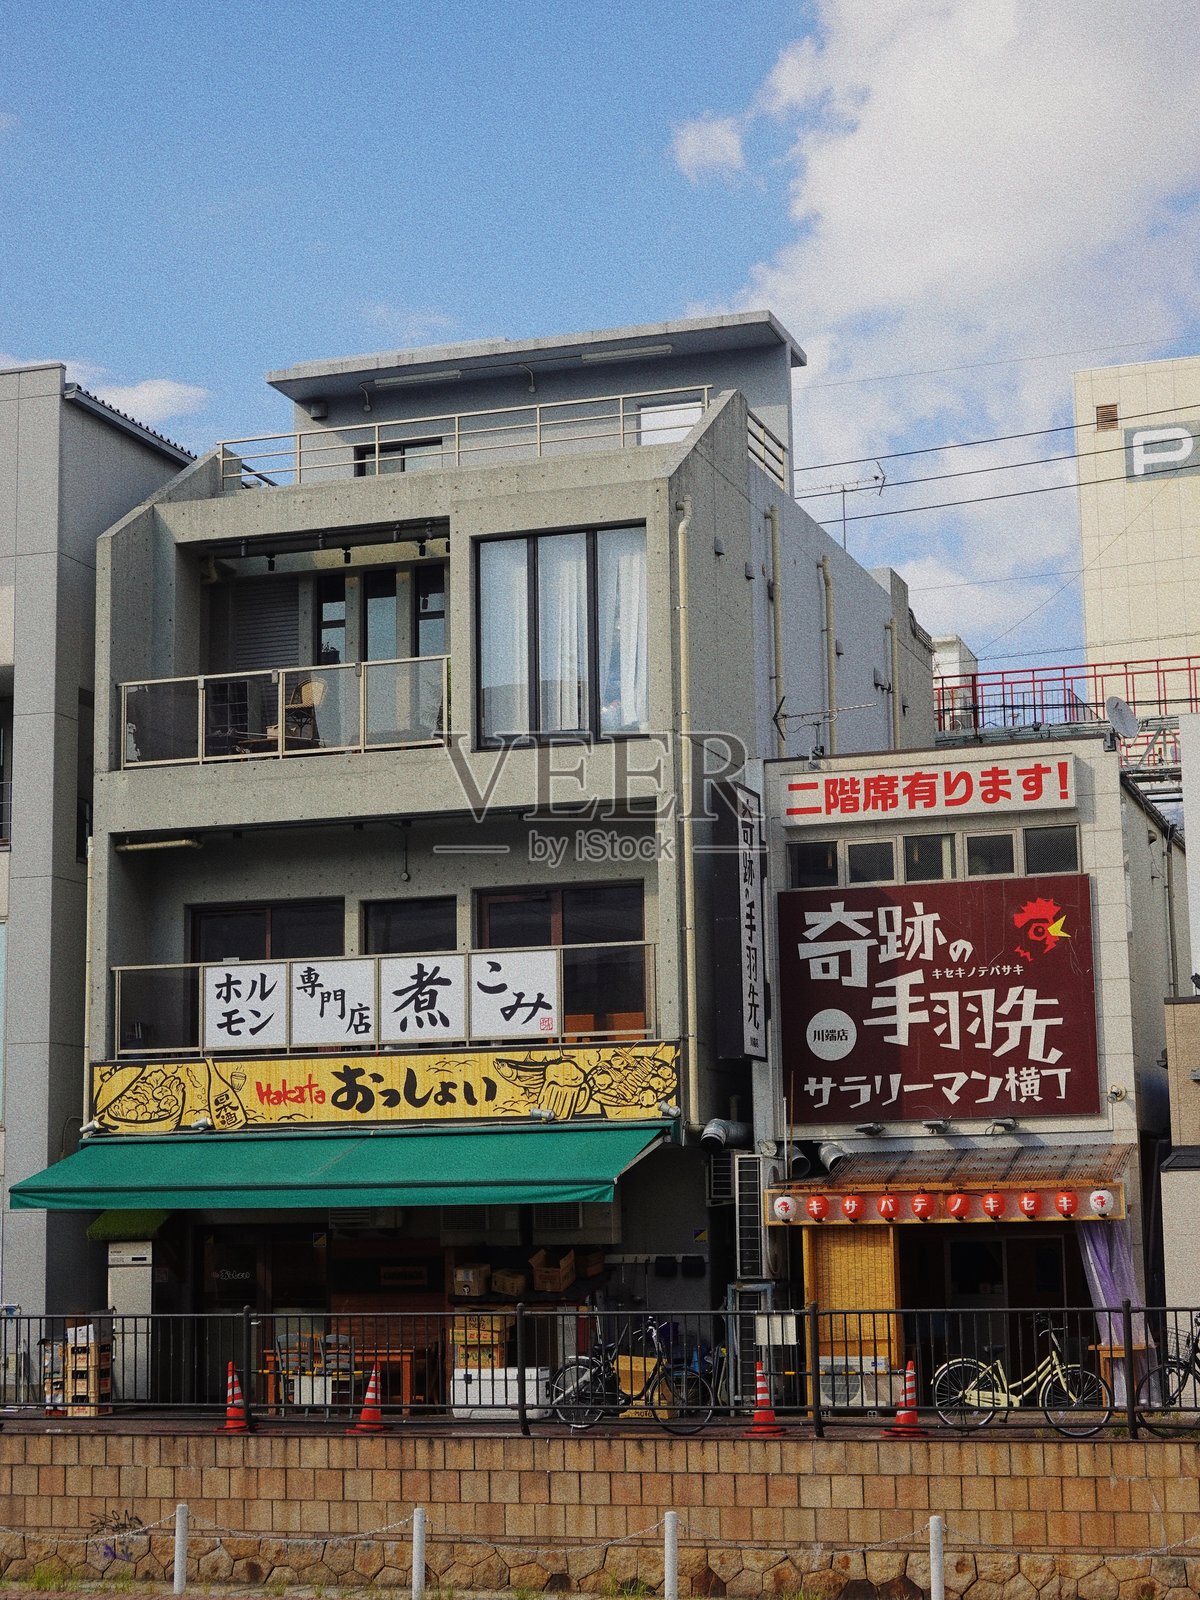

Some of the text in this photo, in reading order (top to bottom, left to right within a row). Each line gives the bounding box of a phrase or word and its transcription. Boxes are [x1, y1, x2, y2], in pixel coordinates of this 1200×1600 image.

[1132, 427, 1194, 477] P
[785, 761, 1069, 816] 二階席有ります!
[797, 901, 974, 988] 奇跡の
[931, 964, 1025, 980] キセキノテバサキ
[296, 966, 372, 1035] 専門店
[862, 968, 1064, 1065] 手羽先
[812, 1028, 849, 1043] 川端店
[255, 1064, 498, 1114] Hakata おっしょい
[803, 1066, 1072, 1109] サラリーマン横丁
